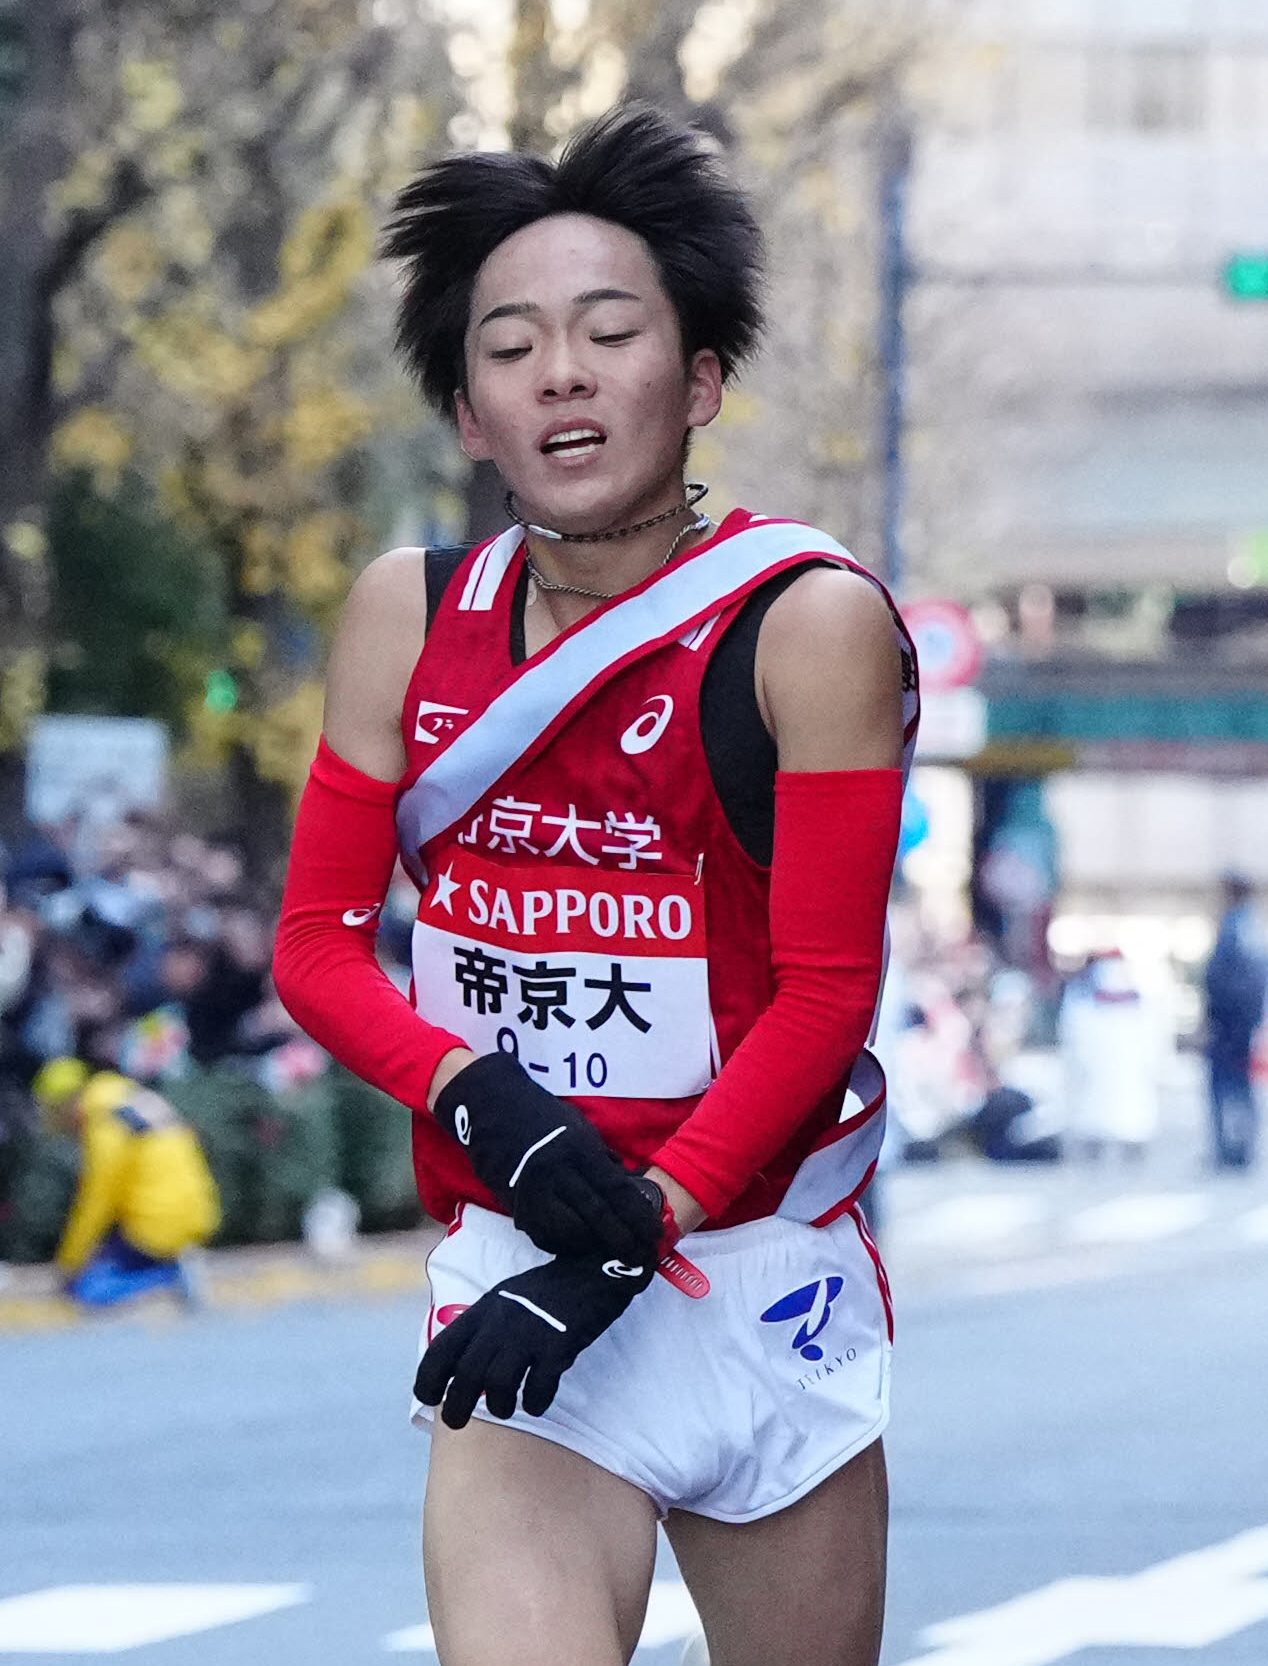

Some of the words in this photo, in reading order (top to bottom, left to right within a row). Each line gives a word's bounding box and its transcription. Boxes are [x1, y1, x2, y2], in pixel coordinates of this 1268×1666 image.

[468, 879, 692, 940] SAPPORO
[453, 946, 652, 1034] 帝京大
